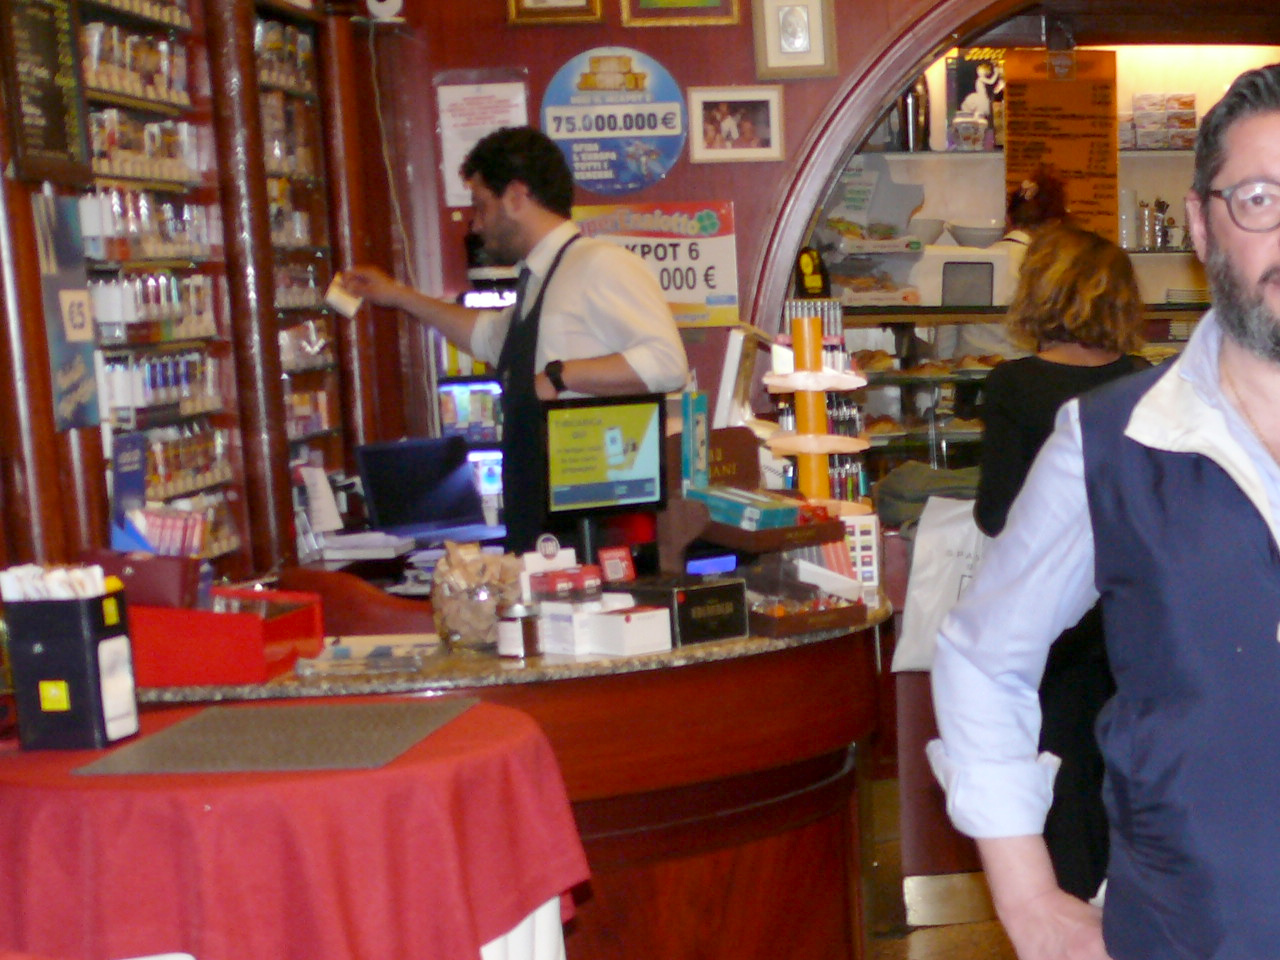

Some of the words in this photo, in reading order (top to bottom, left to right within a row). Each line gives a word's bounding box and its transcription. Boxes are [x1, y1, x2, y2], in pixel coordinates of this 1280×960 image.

[688, 242, 700, 260] 6
[659, 267, 696, 291] 000
[703, 266, 716, 289] €
